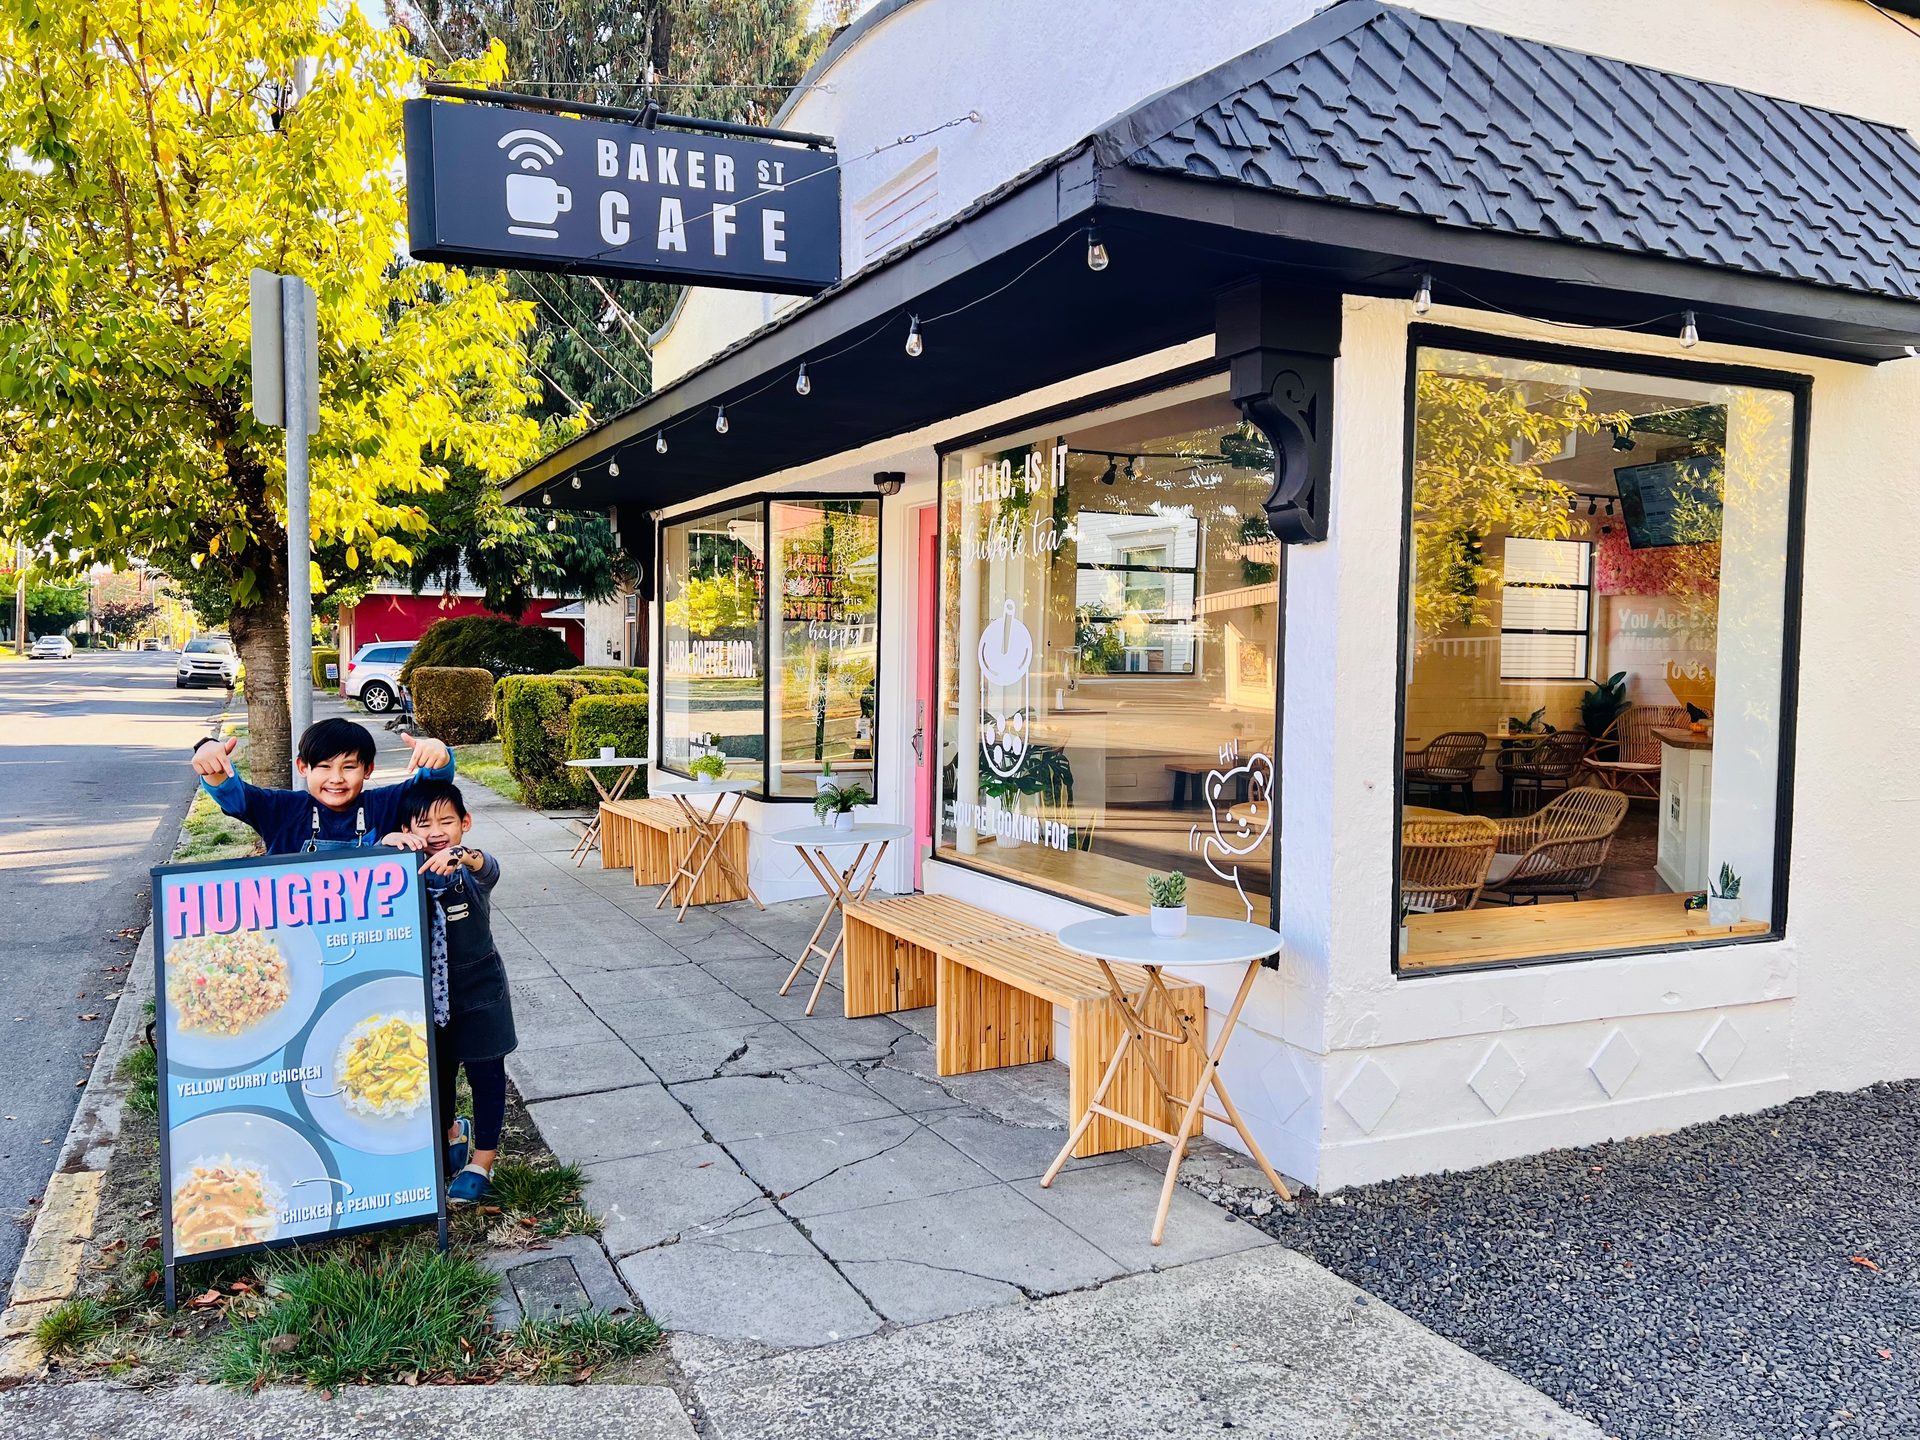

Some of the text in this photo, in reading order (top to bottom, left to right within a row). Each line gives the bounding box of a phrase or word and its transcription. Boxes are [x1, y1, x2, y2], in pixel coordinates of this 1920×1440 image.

[597, 138, 785, 192] BAKER ST
[599, 190, 787, 263] CAFE
[964, 444, 1068, 505] HELLO, IS IT
[964, 508, 1061, 566] bubble tea
[842, 595, 863, 606] this
[808, 619, 860, 651] happy
[1218, 737, 1239, 766] Hi!
[992, 809, 1039, 845] LOOKING
[1044, 820, 1069, 852] FOR
[167, 863, 409, 940] HUNGRY?
[326, 926, 412, 948] EGG FRIED RICE
[176, 1065, 322, 1098] YELLOW CURRY CHICKEN
[281, 1186, 432, 1225] CHICKEN & PEANUT SAUCE
